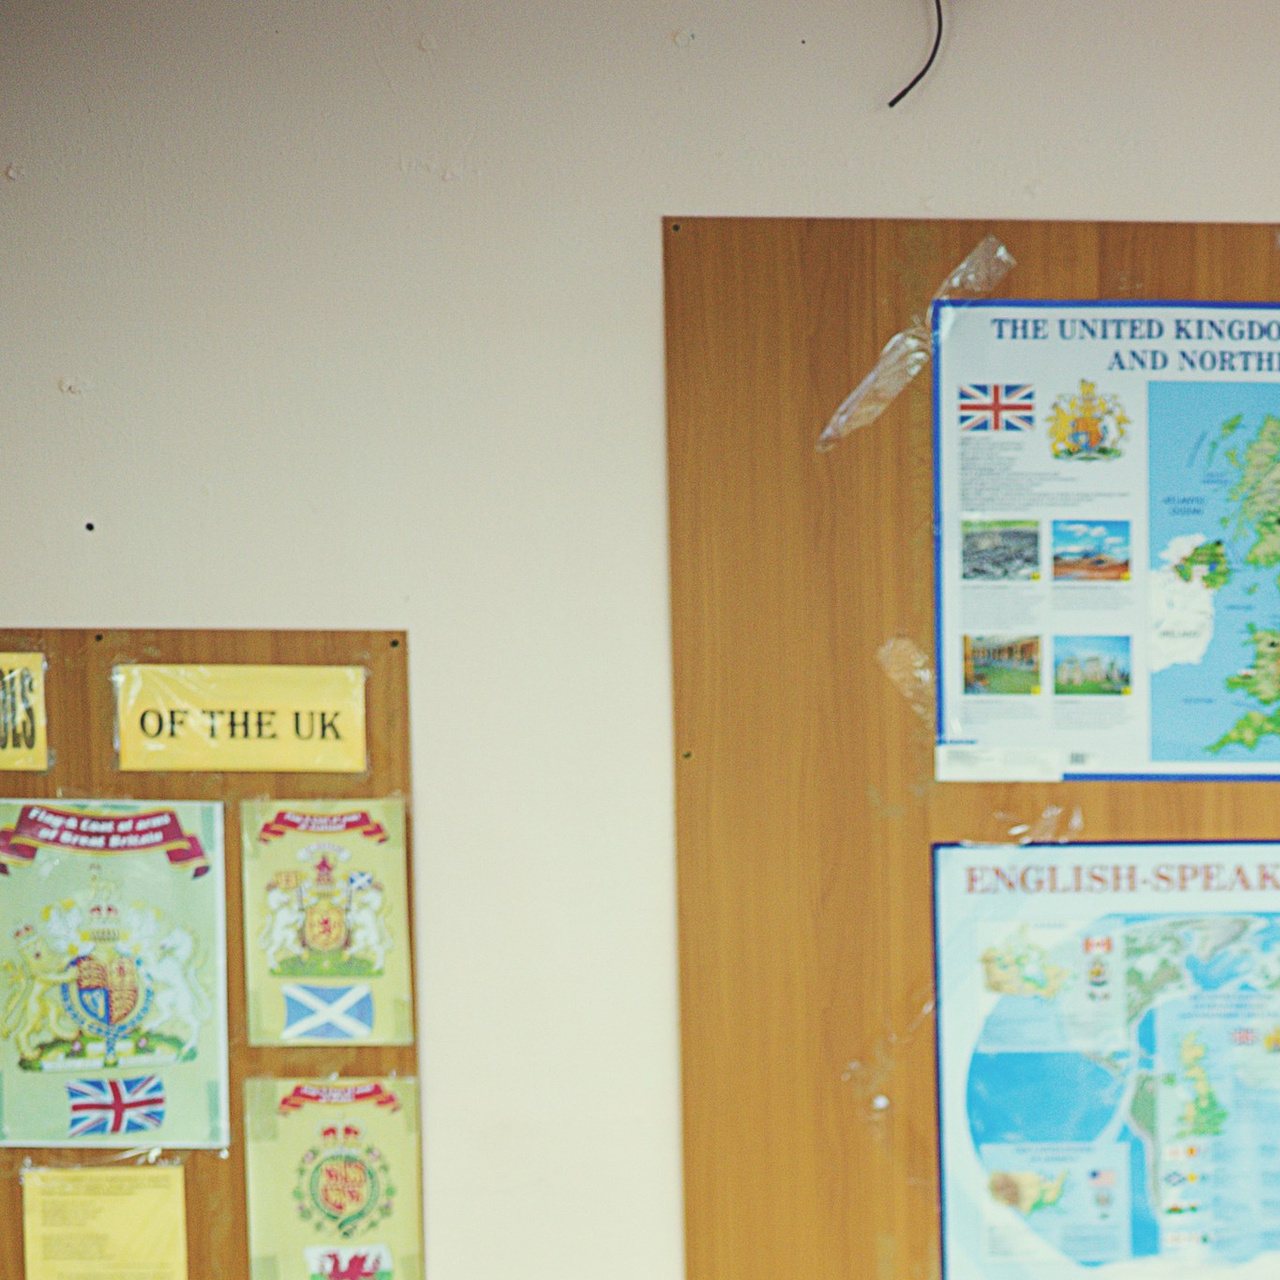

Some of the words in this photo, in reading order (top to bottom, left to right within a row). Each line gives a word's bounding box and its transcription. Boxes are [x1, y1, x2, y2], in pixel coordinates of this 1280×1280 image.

[991, 318, 1049, 340] THE
[1058, 318, 1164, 341] UNITED
[1107, 350, 1168, 371] AND
[140, 709, 188, 738] OF
[202, 709, 277, 739] THE
[294, 711, 341, 740] UK
